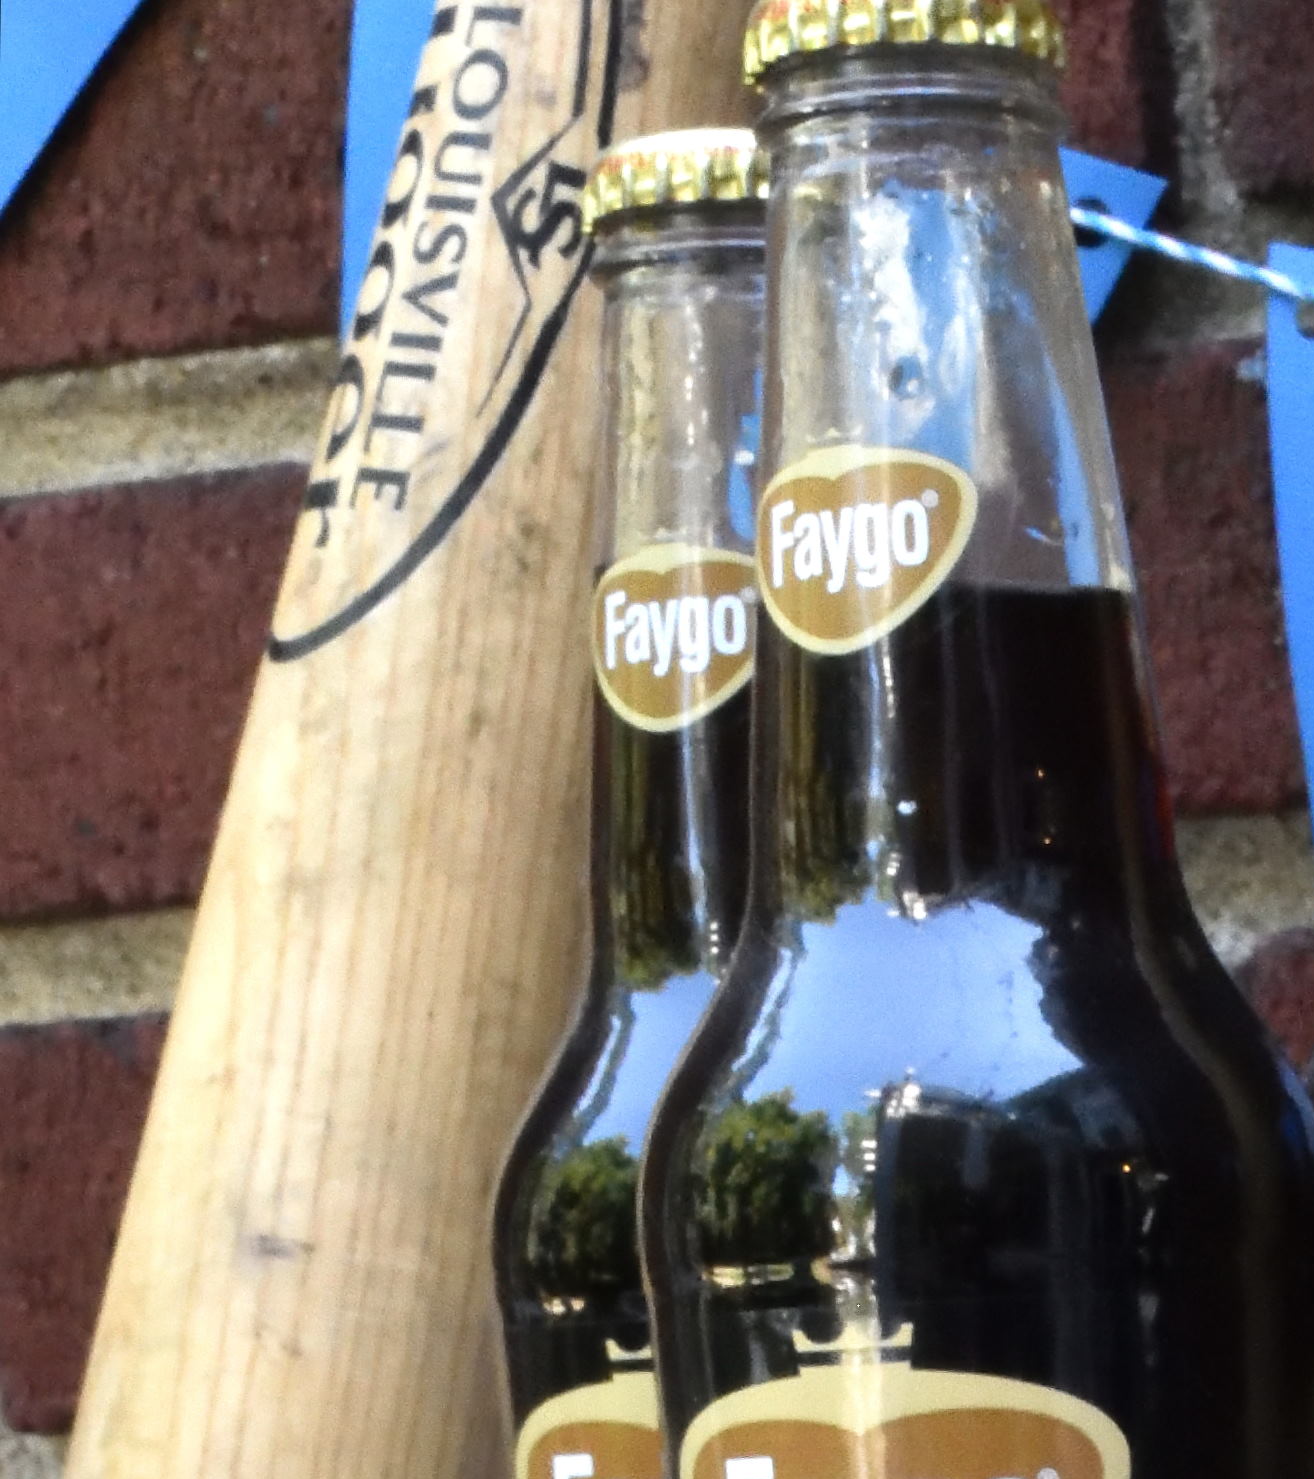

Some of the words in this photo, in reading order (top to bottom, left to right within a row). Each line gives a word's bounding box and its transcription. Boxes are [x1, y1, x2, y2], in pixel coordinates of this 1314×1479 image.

[350, 4, 522, 512] LOUISVILLE
[769, 496, 929, 593] Faygo
[603, 590, 746, 676] Faygo
